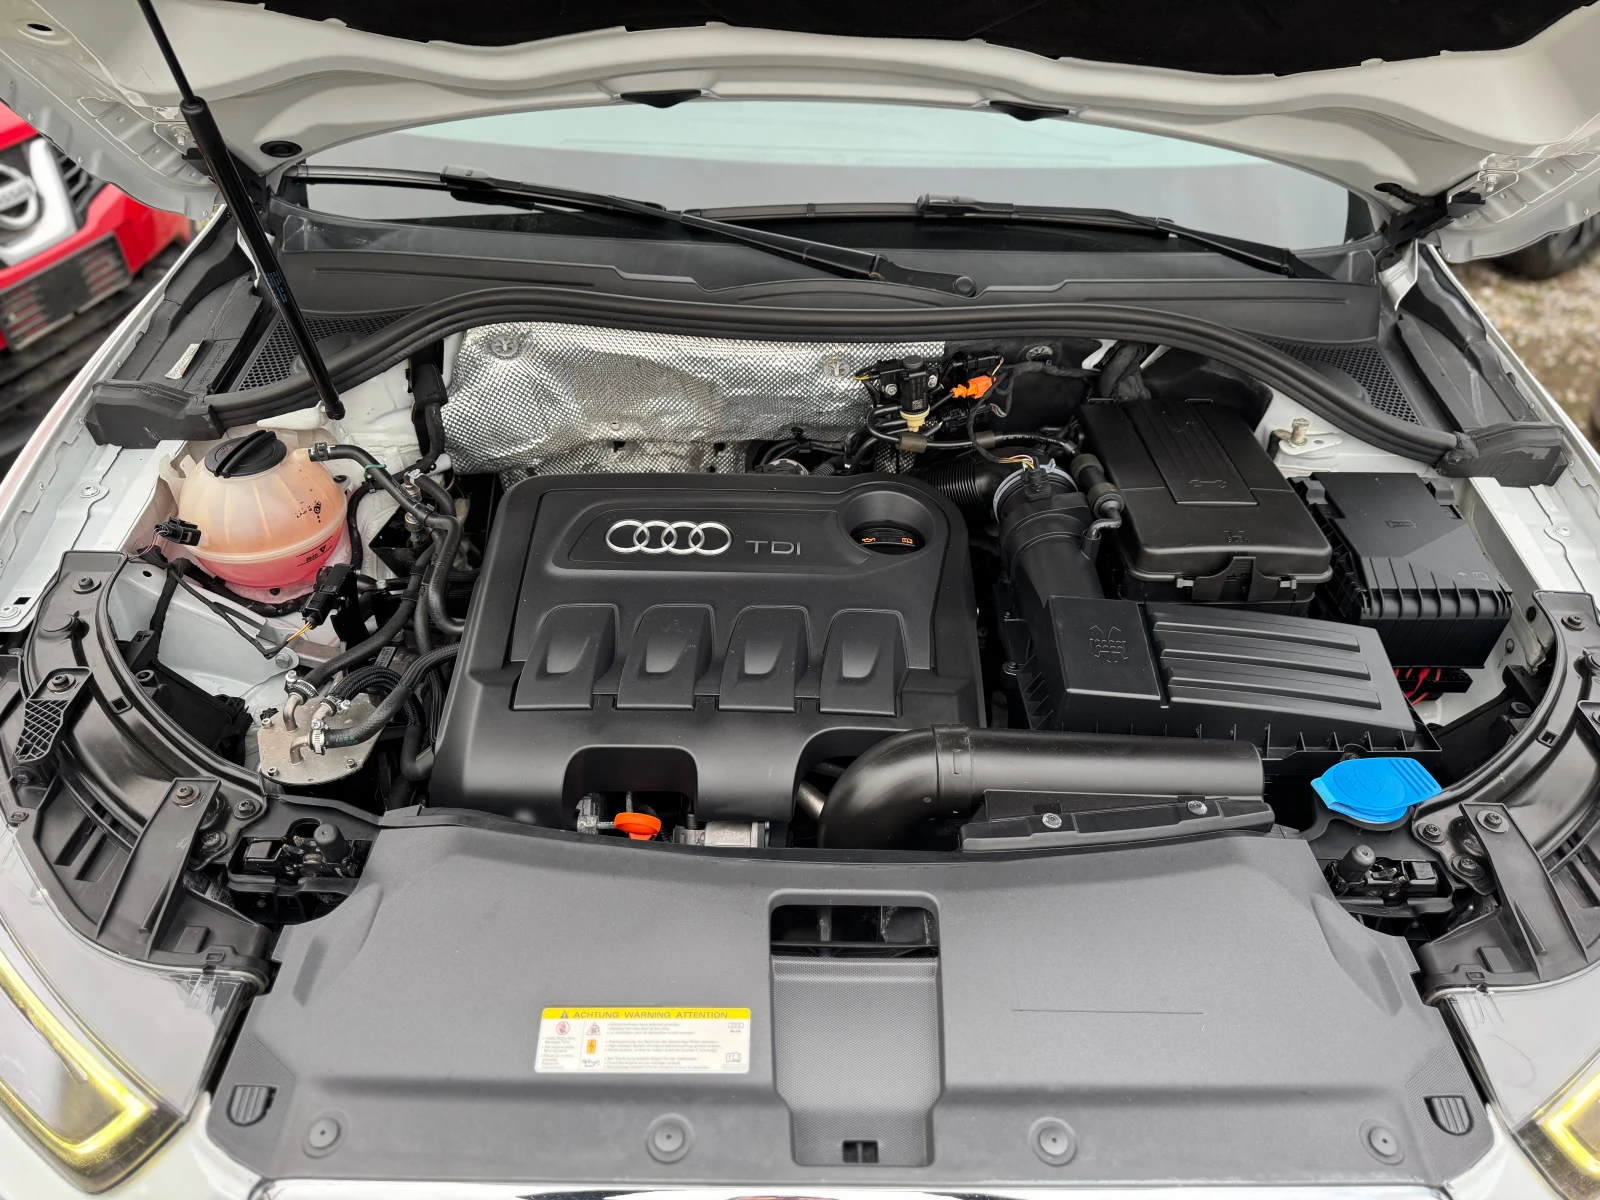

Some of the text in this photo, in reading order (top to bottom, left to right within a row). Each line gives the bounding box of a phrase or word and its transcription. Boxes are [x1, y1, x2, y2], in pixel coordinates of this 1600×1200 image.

[745, 540, 801, 556] TDI
[306, 552, 319, 562] min
[573, 1011, 728, 1019] ACHTUNG WARNING ATTENTION
